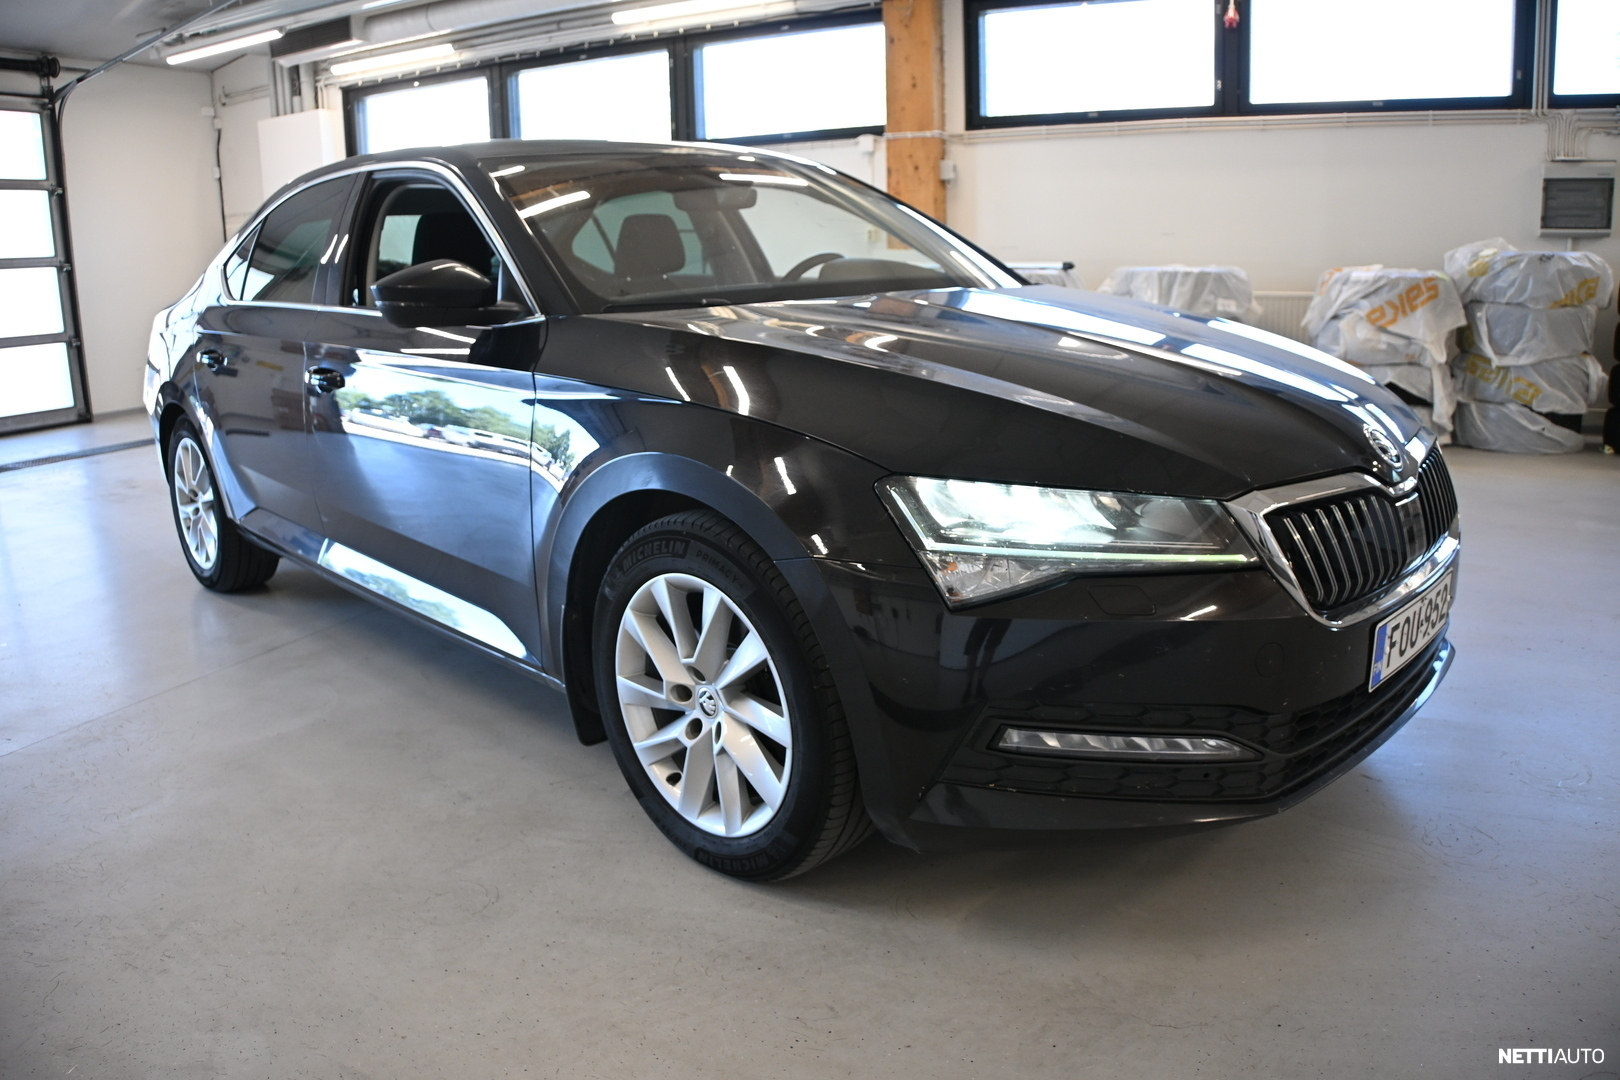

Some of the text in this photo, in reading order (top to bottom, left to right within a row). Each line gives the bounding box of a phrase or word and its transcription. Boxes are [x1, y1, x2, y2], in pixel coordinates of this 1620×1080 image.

[622, 540, 687, 572] MICHELIN
[695, 549, 741, 585] PRIMACY
[1386, 583, 1448, 669] FOU-952
